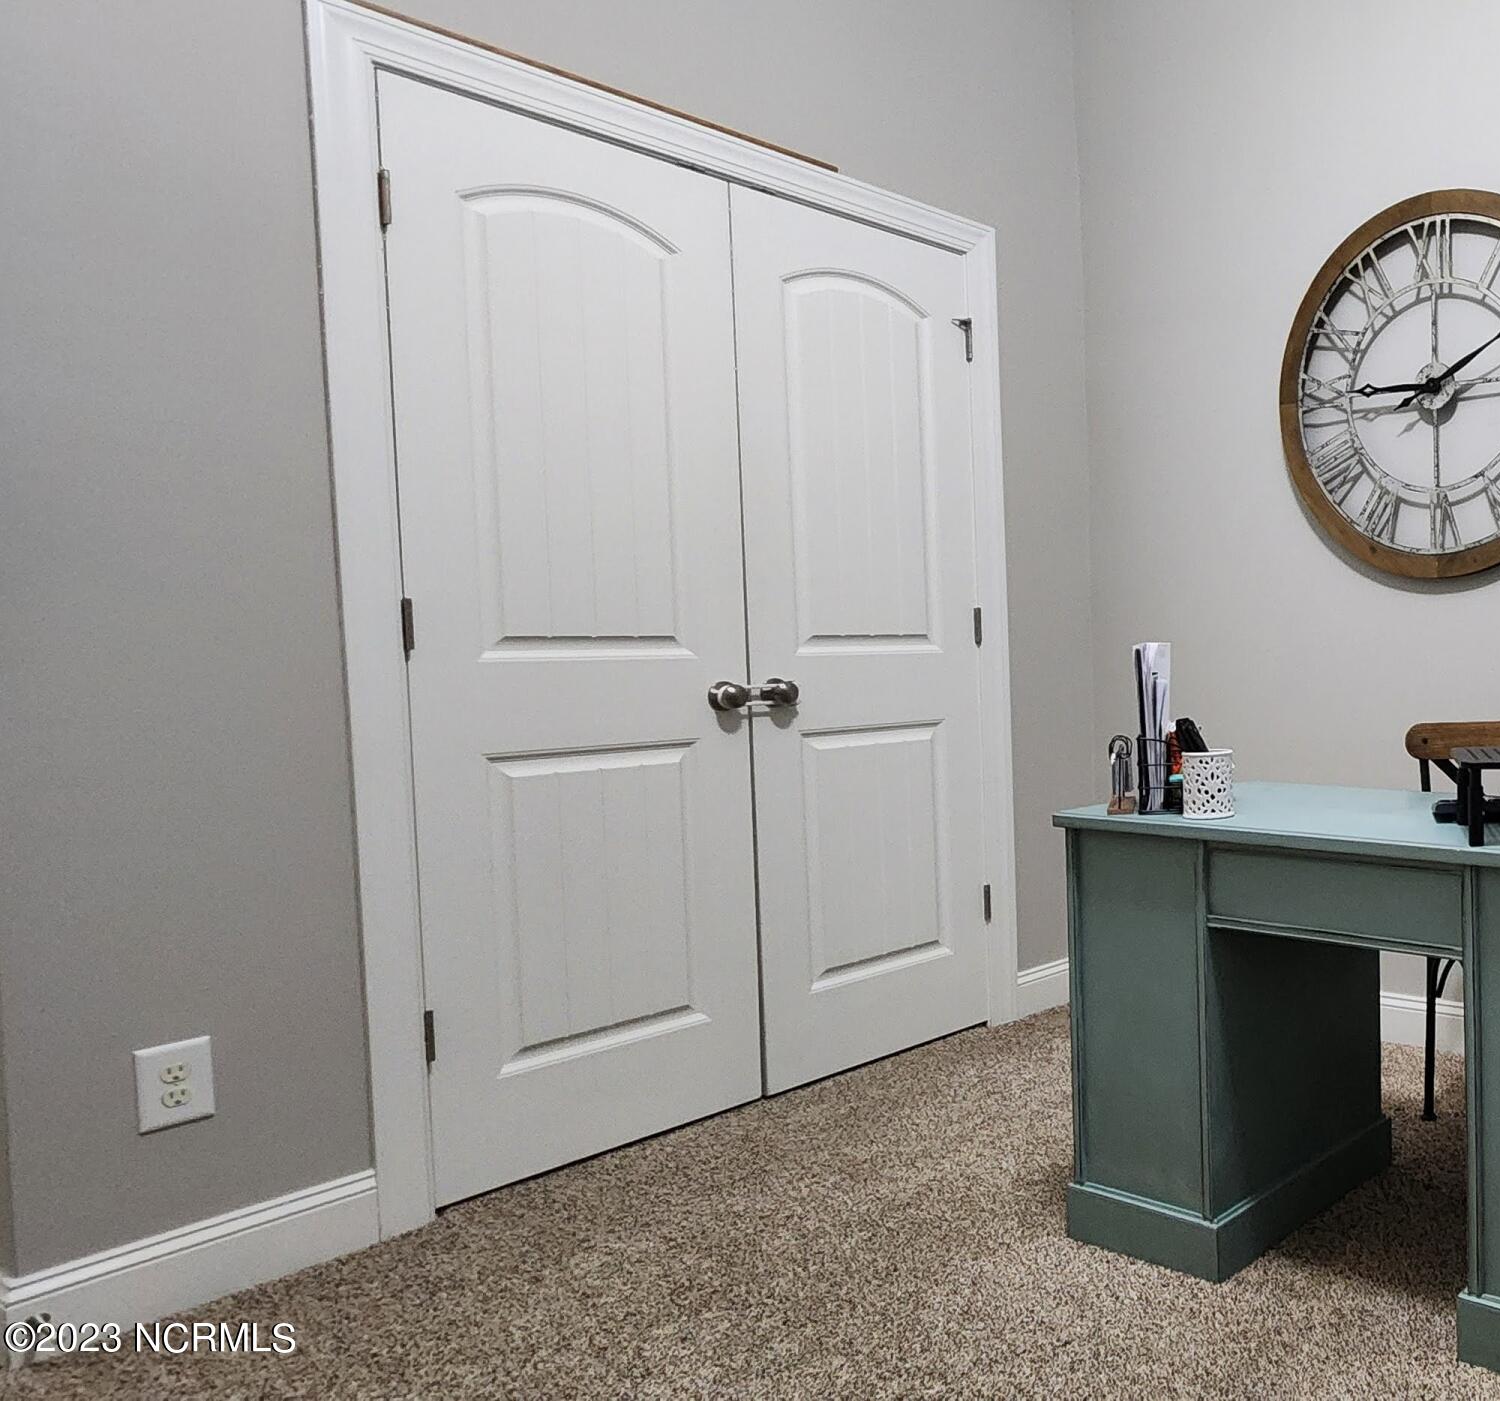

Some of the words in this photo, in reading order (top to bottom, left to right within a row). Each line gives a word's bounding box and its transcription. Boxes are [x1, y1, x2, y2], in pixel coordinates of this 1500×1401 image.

[1344, 248, 1394, 320] XI
[1406, 217, 1453, 284] XII
[1310, 309, 1364, 358] X
